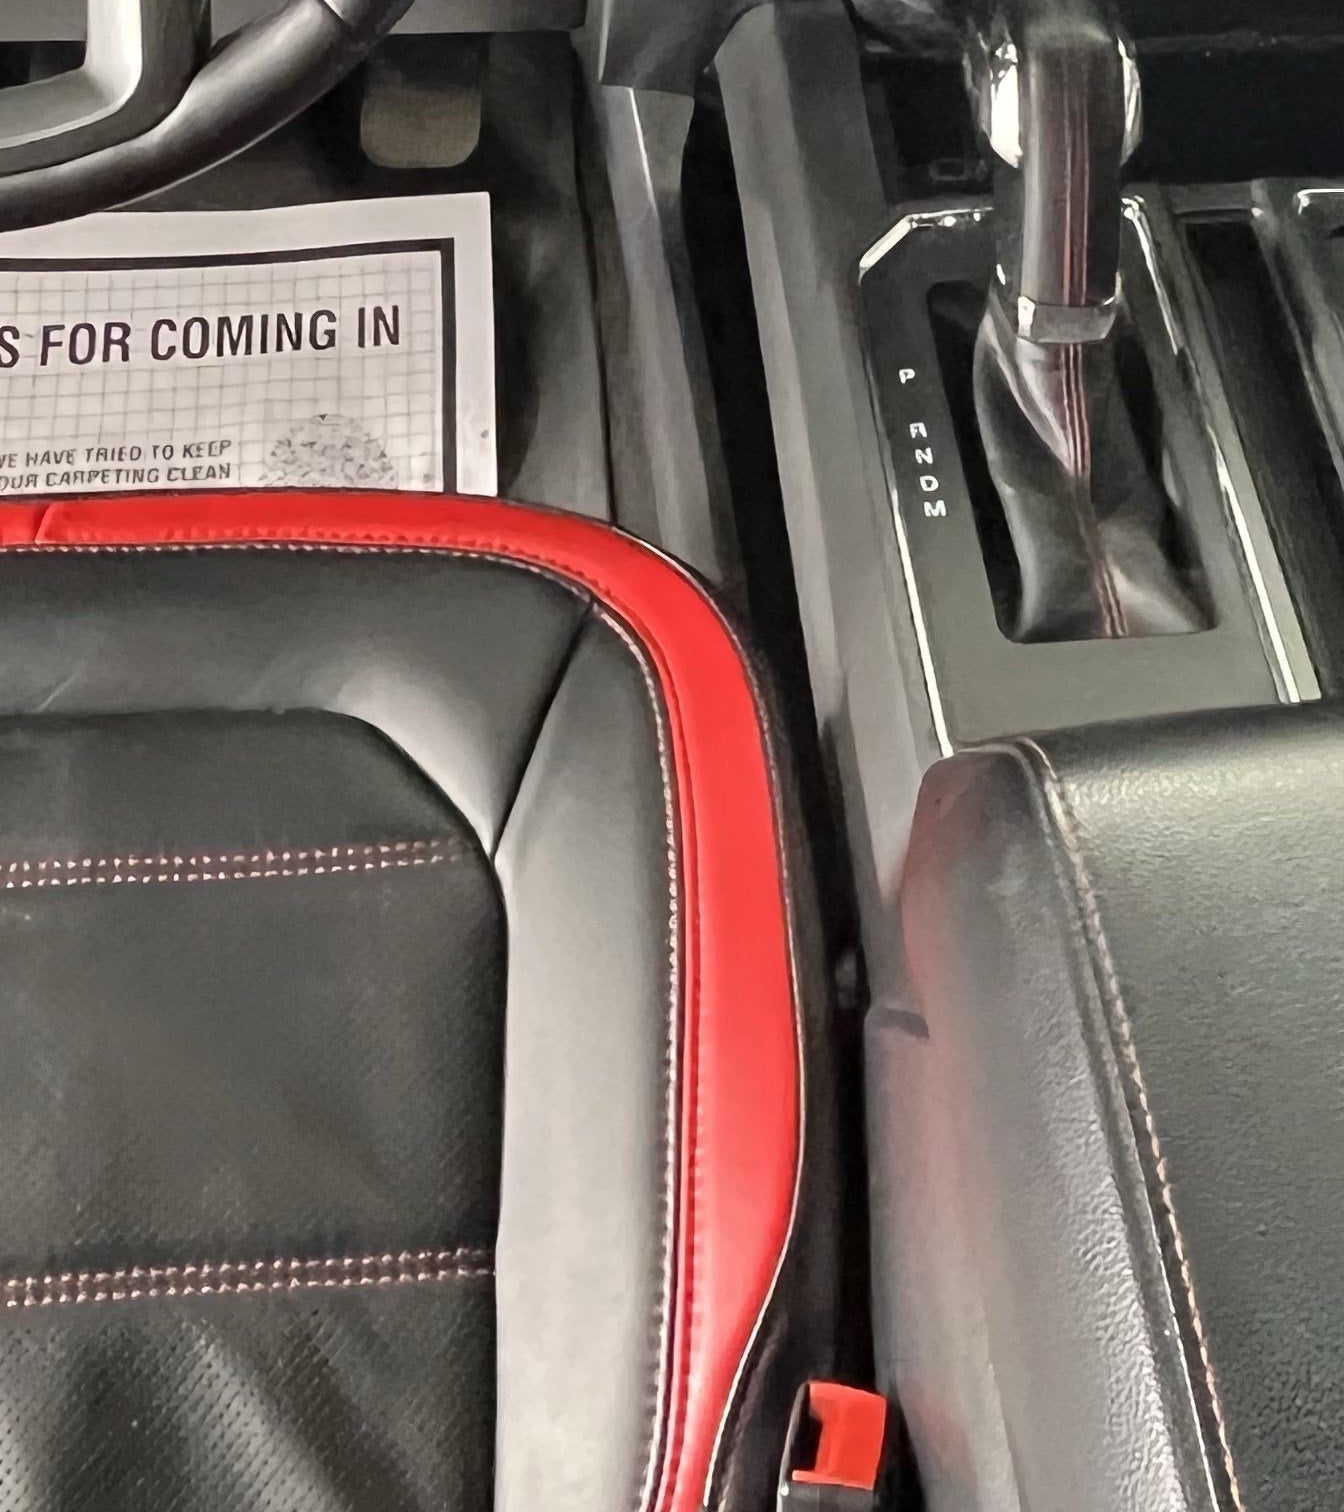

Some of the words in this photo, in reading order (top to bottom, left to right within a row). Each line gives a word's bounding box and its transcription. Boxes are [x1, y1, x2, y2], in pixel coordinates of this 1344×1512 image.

[39, 321, 131, 366] FOR
[151, 309, 337, 361] COMING
[358, 305, 400, 348] IN
[899, 368, 916, 384] P
[25, 448, 77, 467] HAVE
[85, 445, 142, 463] TRIED
[152, 444, 174, 461] TO
[182, 439, 232, 459] KEEP
[914, 447, 933, 465] N
[45, 467, 160, 486] CARPETING
[167, 462, 231, 481] CLEAN
[919, 474, 939, 492] D
[923, 499, 947, 517] M
